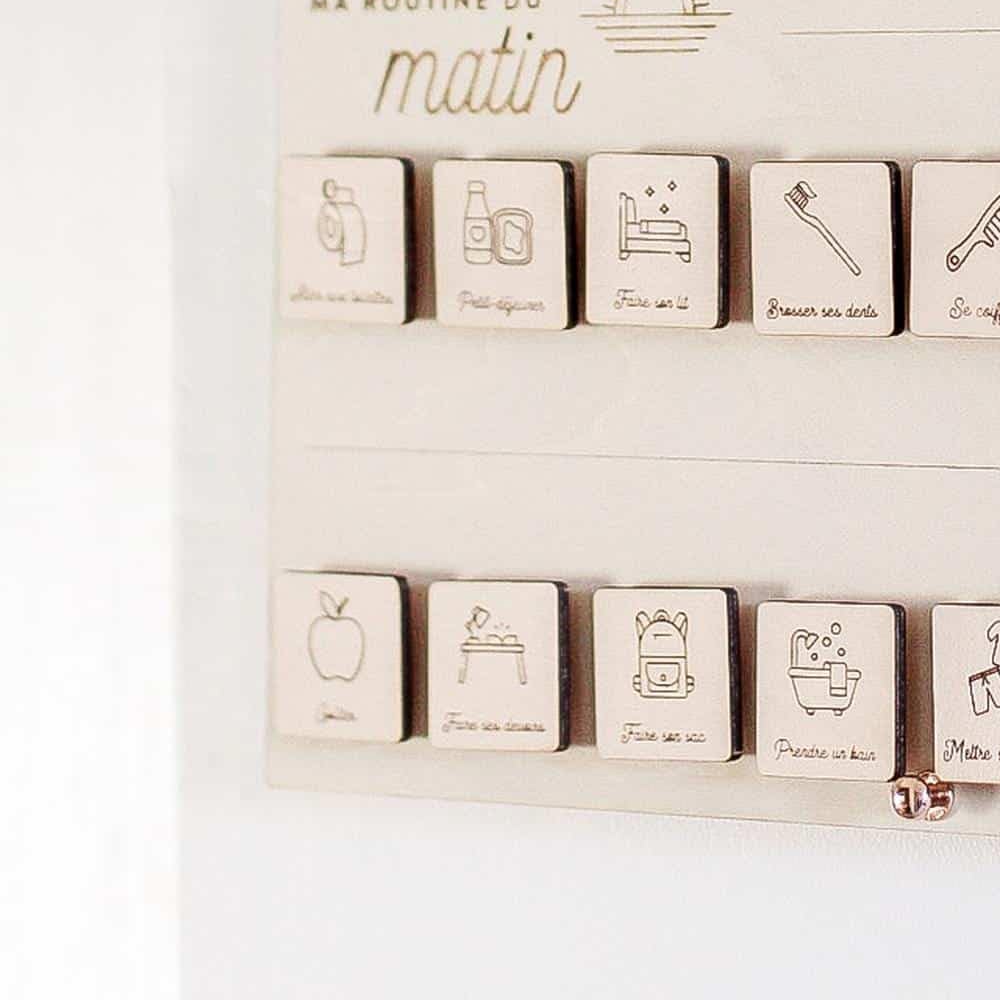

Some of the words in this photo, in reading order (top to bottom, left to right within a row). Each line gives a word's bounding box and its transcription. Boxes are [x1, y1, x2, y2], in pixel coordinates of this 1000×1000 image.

[373, 25, 582, 116] matin
[766, 298, 818, 320] Brosser
[821, 306, 842, 318] ses
[845, 300, 879, 319] dents
[949, 296, 972, 320] Se
[774, 738, 829, 761] Prendre
[832, 748, 848, 760] un
[850, 744, 877, 762] bain
[943, 738, 993, 763] Mettre
